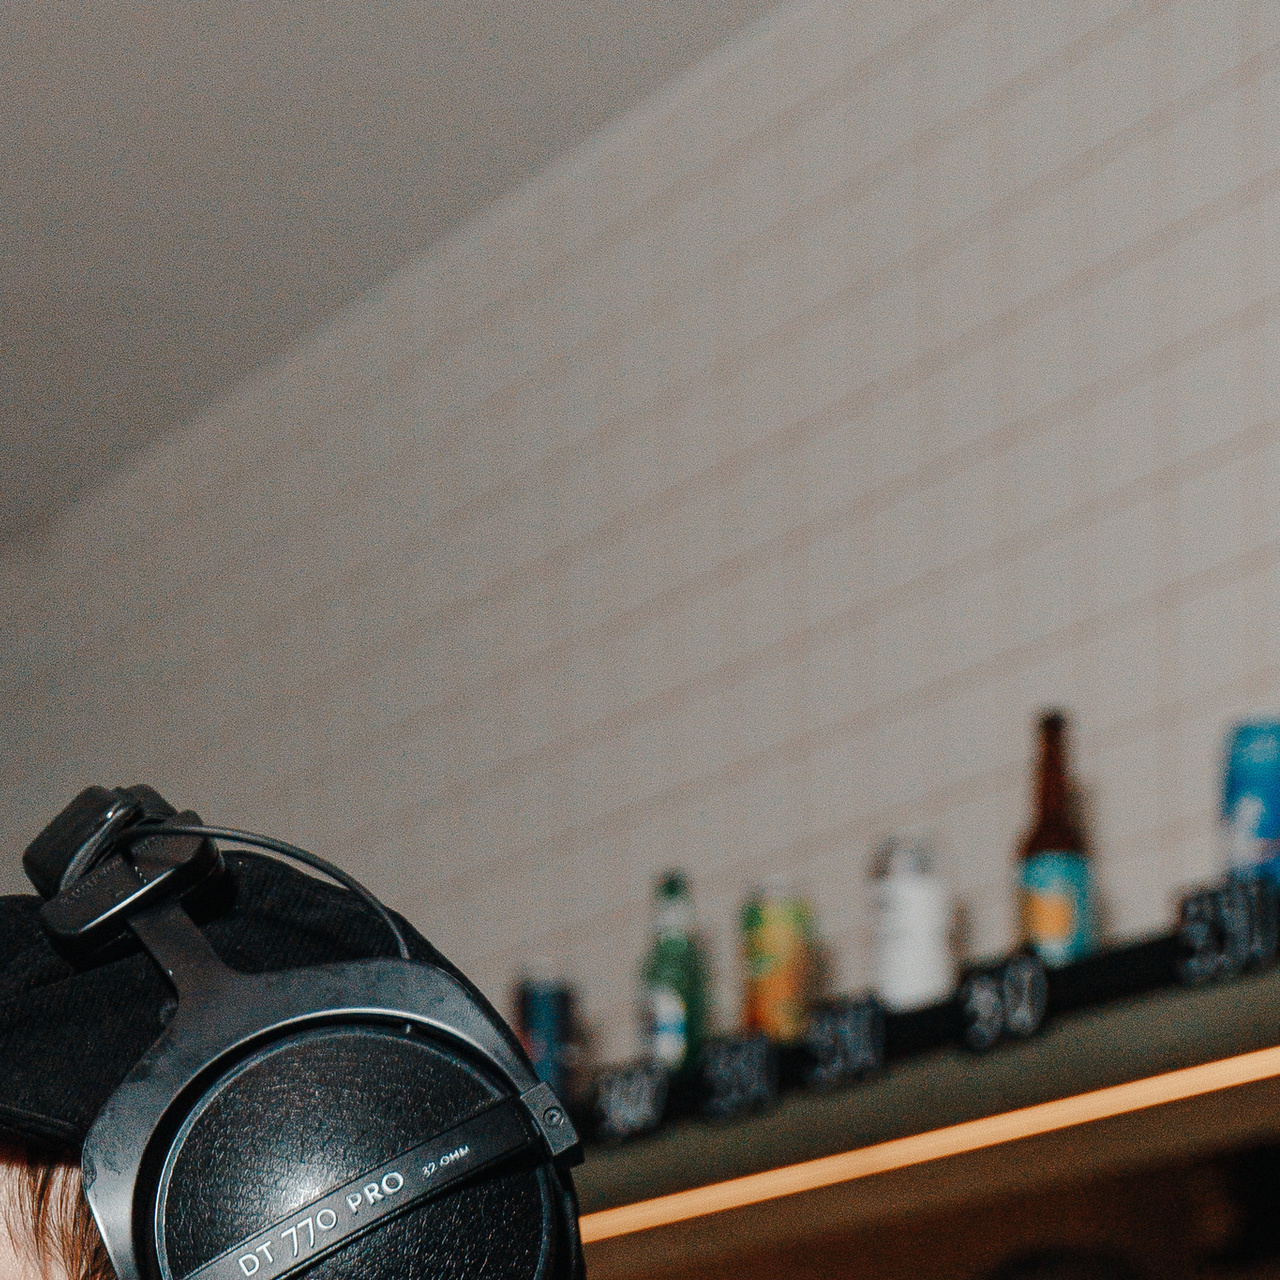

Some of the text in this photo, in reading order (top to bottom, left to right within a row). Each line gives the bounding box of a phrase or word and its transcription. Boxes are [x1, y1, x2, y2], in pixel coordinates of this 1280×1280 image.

[238, 1144, 471, 1278] DT 770 PRO 32 OHM
